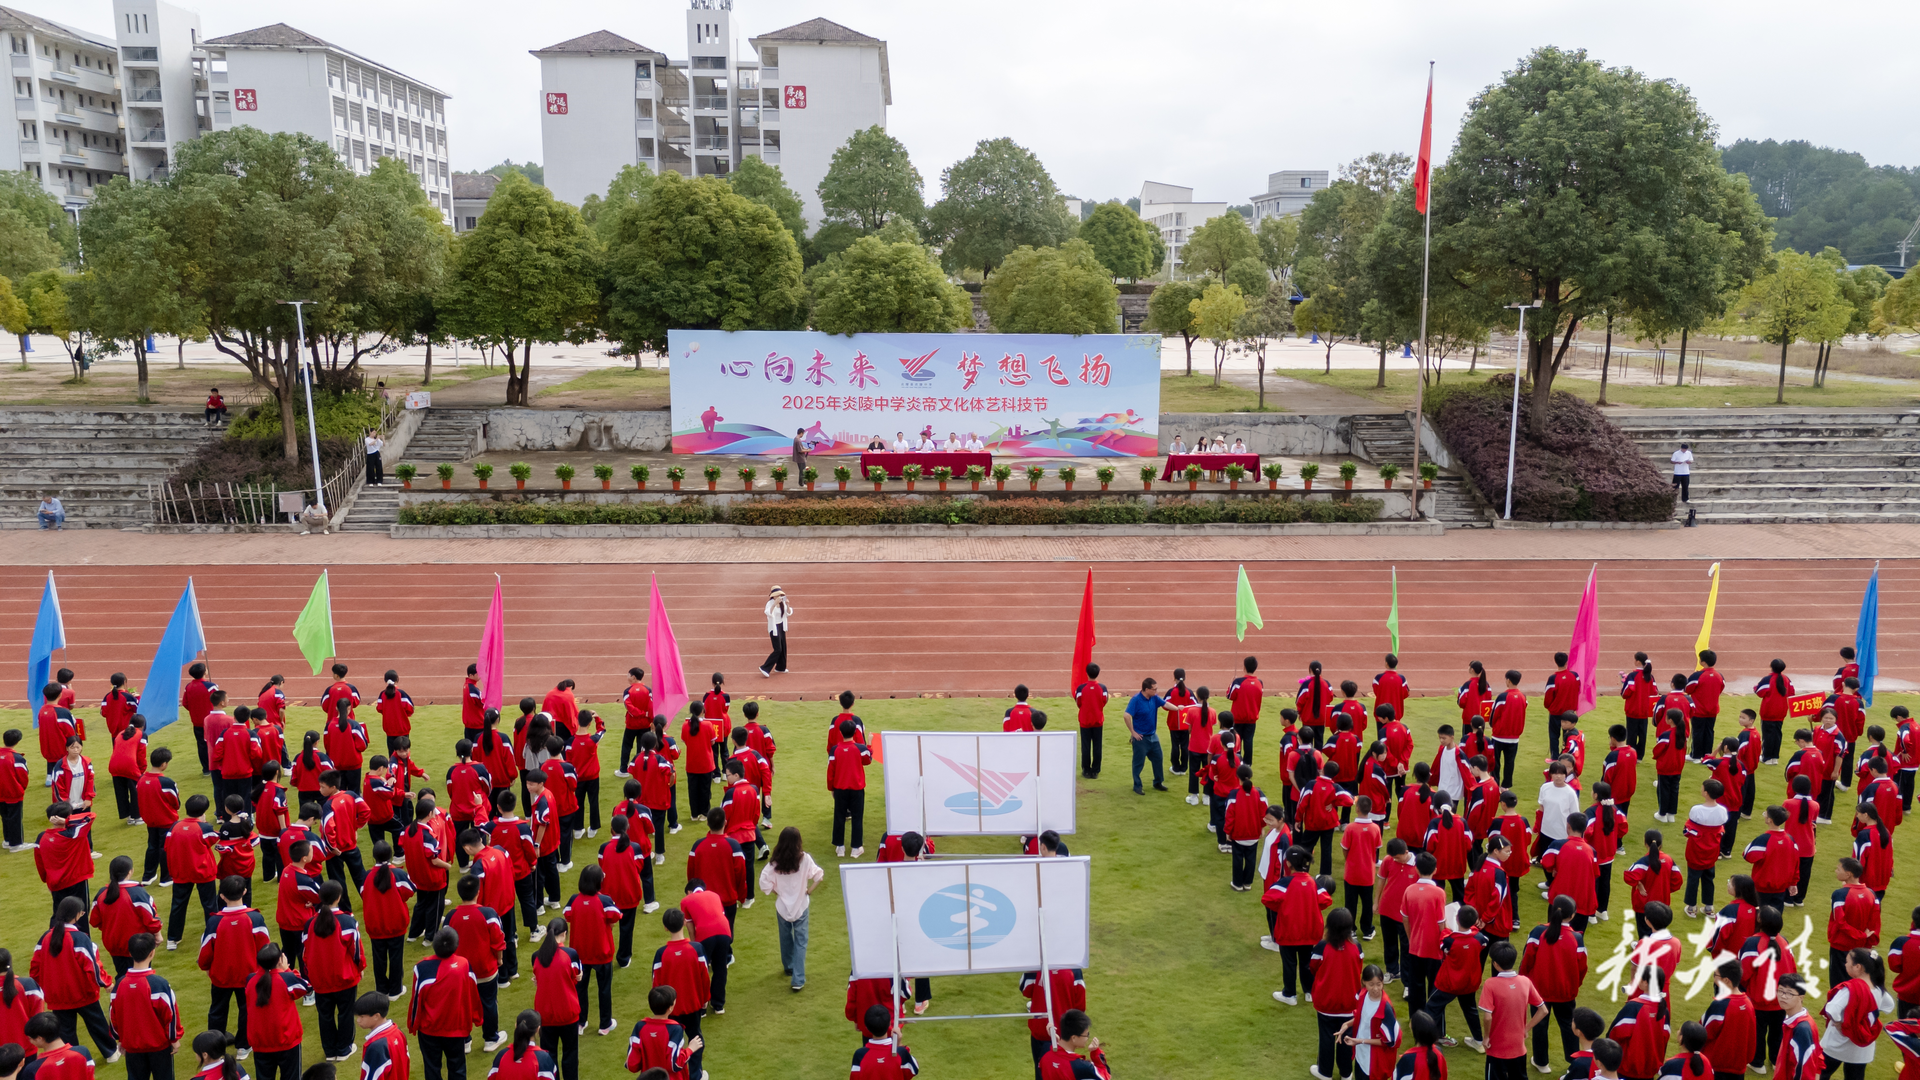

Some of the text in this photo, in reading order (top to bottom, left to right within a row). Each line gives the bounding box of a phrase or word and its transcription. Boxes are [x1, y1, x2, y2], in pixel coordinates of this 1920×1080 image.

[720, 349, 1112, 391] 心向未来 梦想飞扬
[782, 395, 1048, 412] 2025年炎陵中学炎帝文化体艺科技节
[1792, 696, 1823, 713] 275班
